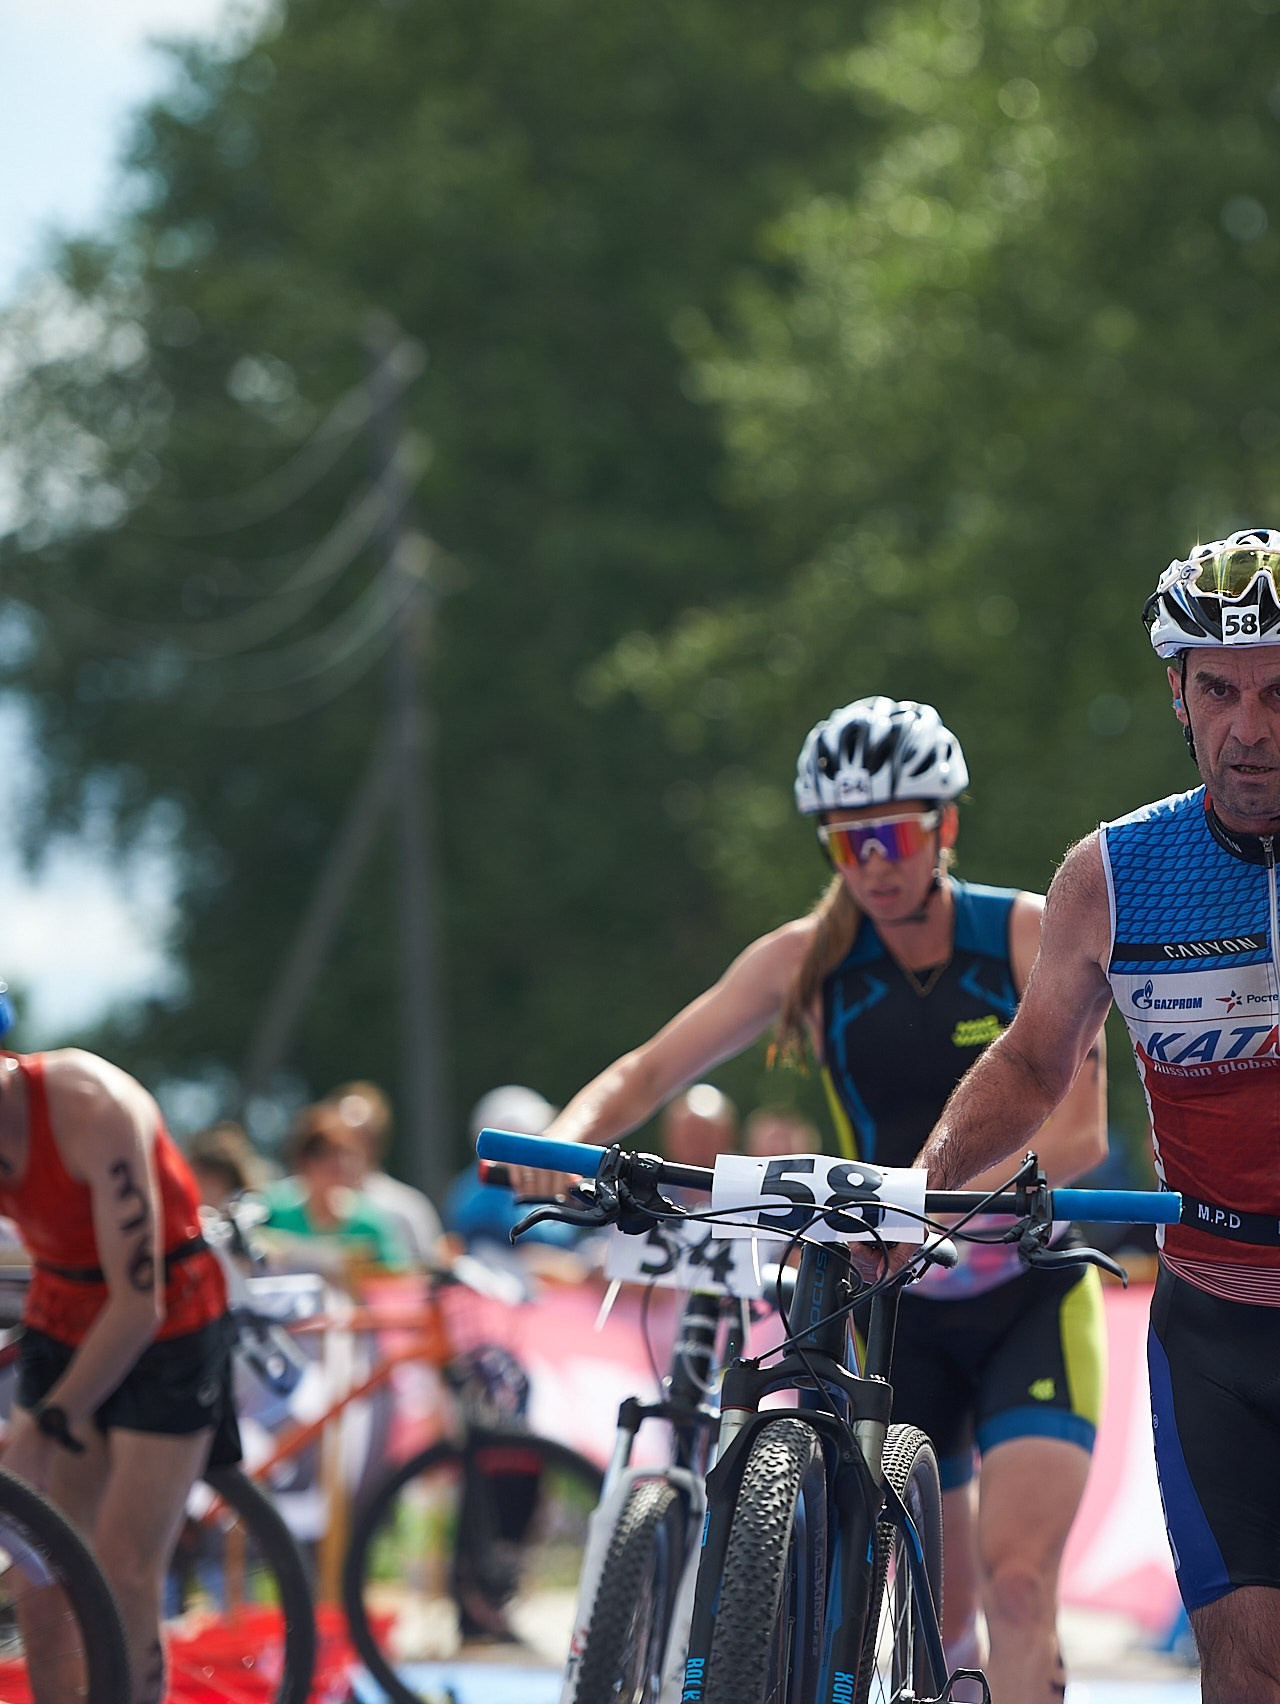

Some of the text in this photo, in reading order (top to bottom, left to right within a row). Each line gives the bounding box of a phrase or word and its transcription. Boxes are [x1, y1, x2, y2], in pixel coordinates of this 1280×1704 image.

[1225, 613, 1258, 636] 58
[1163, 937, 1258, 958] CANYON
[1153, 997, 1203, 1010] GAZPROM
[758, 1158, 886, 1234] 58
[808, 1250, 829, 1343] FOCUS
